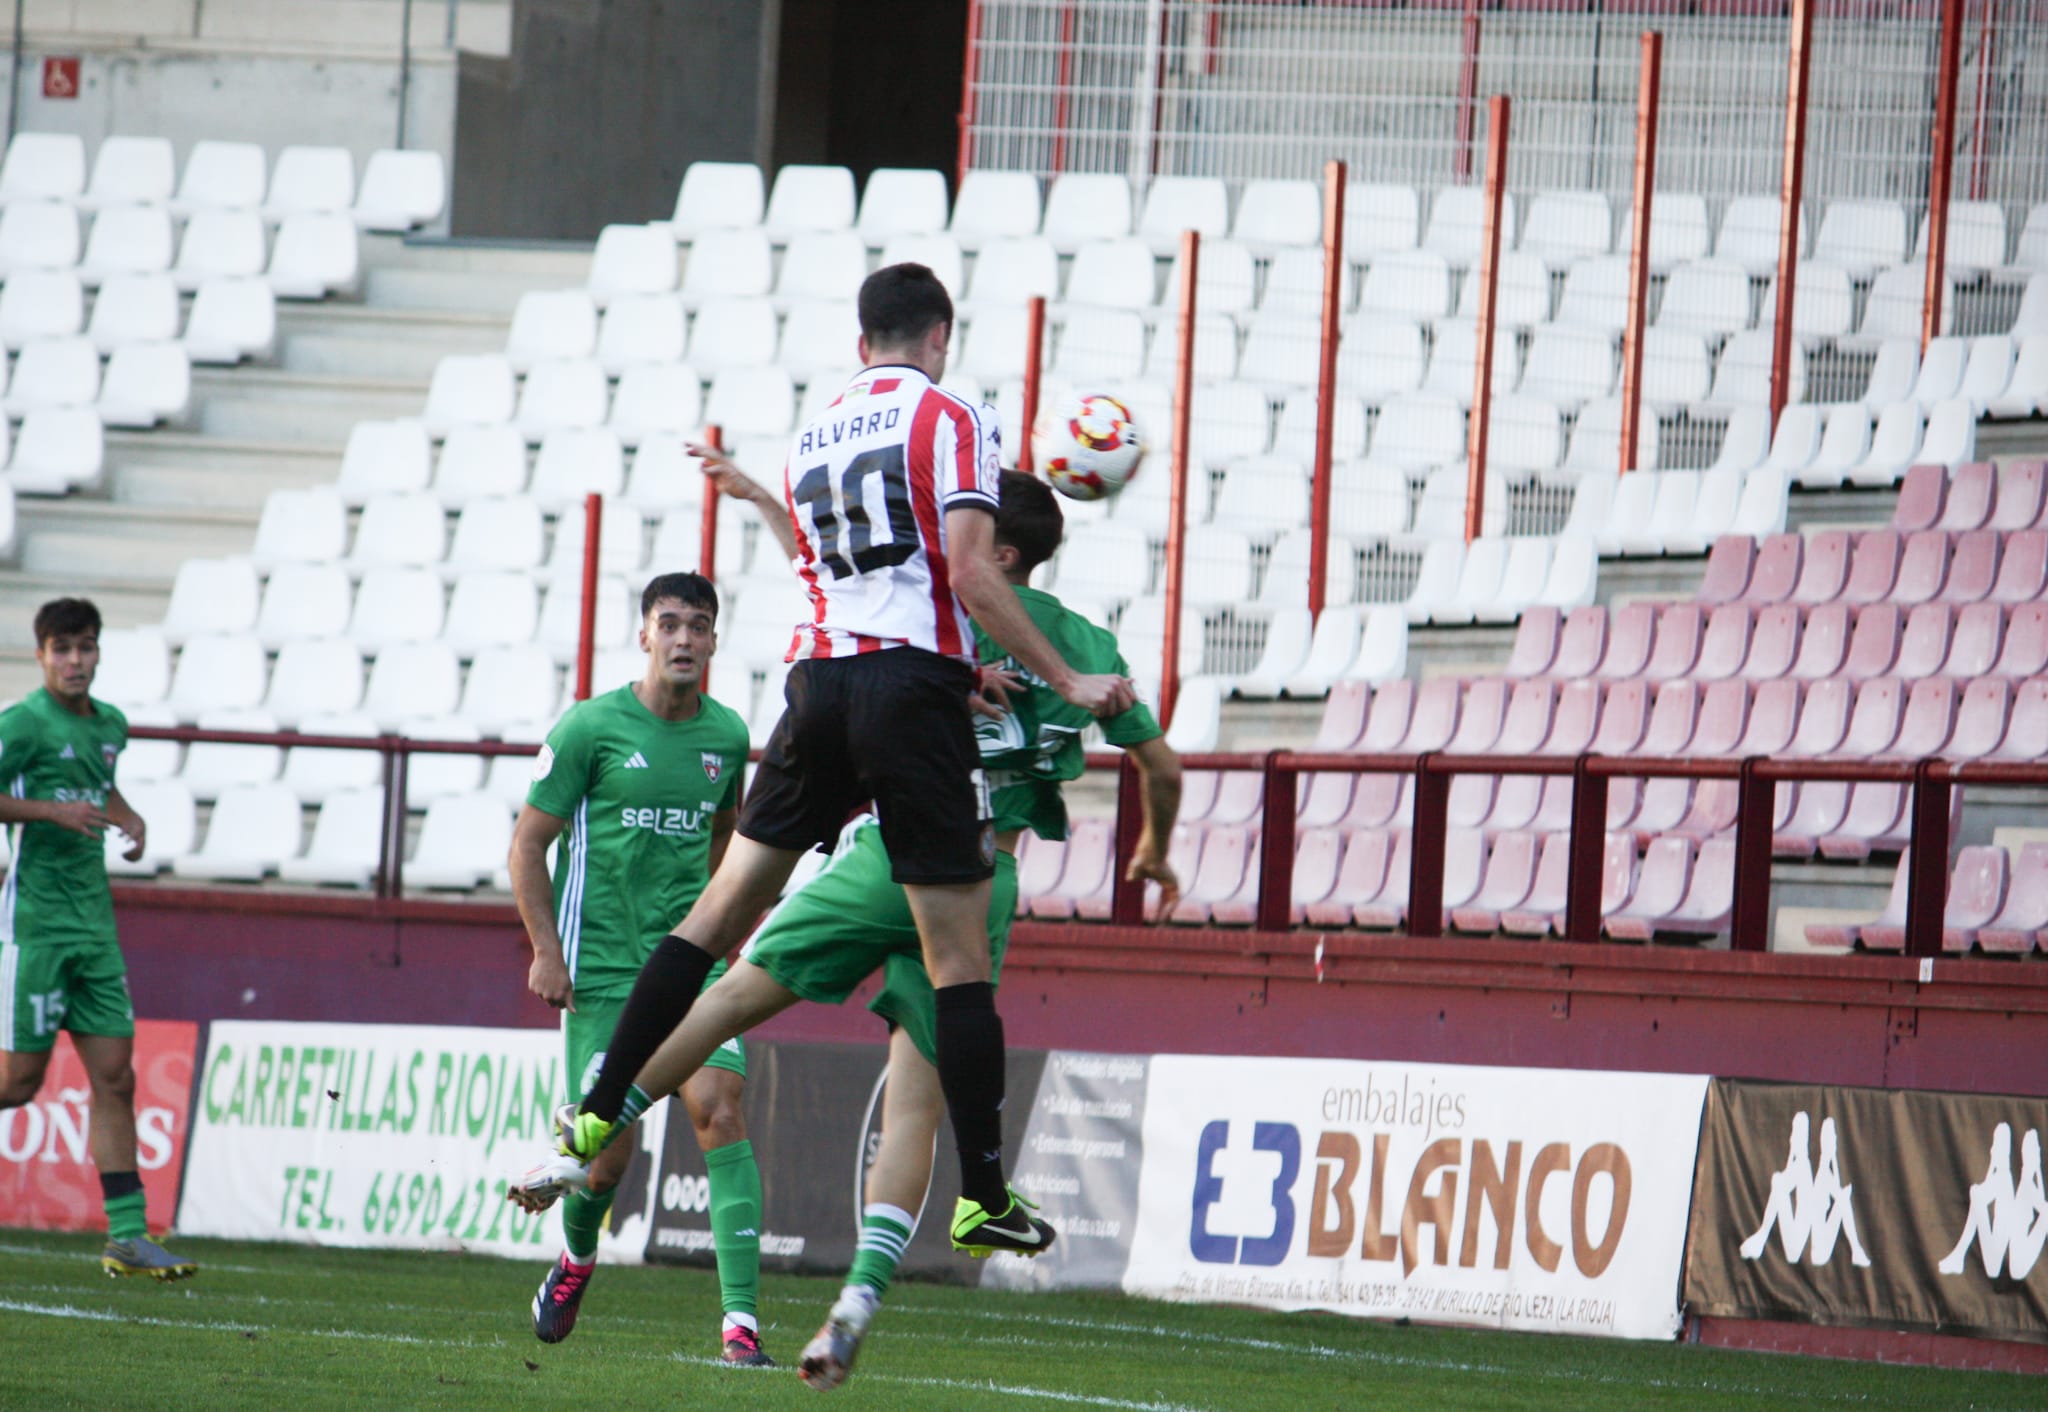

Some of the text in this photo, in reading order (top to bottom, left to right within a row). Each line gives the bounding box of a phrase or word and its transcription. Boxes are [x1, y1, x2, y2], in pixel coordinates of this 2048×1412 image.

[793, 444, 920, 581] 10
[28, 989, 66, 1036] 15
[0, 1086, 175, 1171] OÑS
[205, 1043, 567, 1159] CARRETILLAS RIOJAN
[1321, 1071, 1467, 1143] embalajes
[279, 1166, 345, 1231] TEL.
[1307, 1130, 1633, 1281] BLANCO
[1432, 1287, 1484, 1316] MURILLO
[1483, 1292, 1499, 1316] DE
[1525, 1295, 1554, 1320] LEZA
